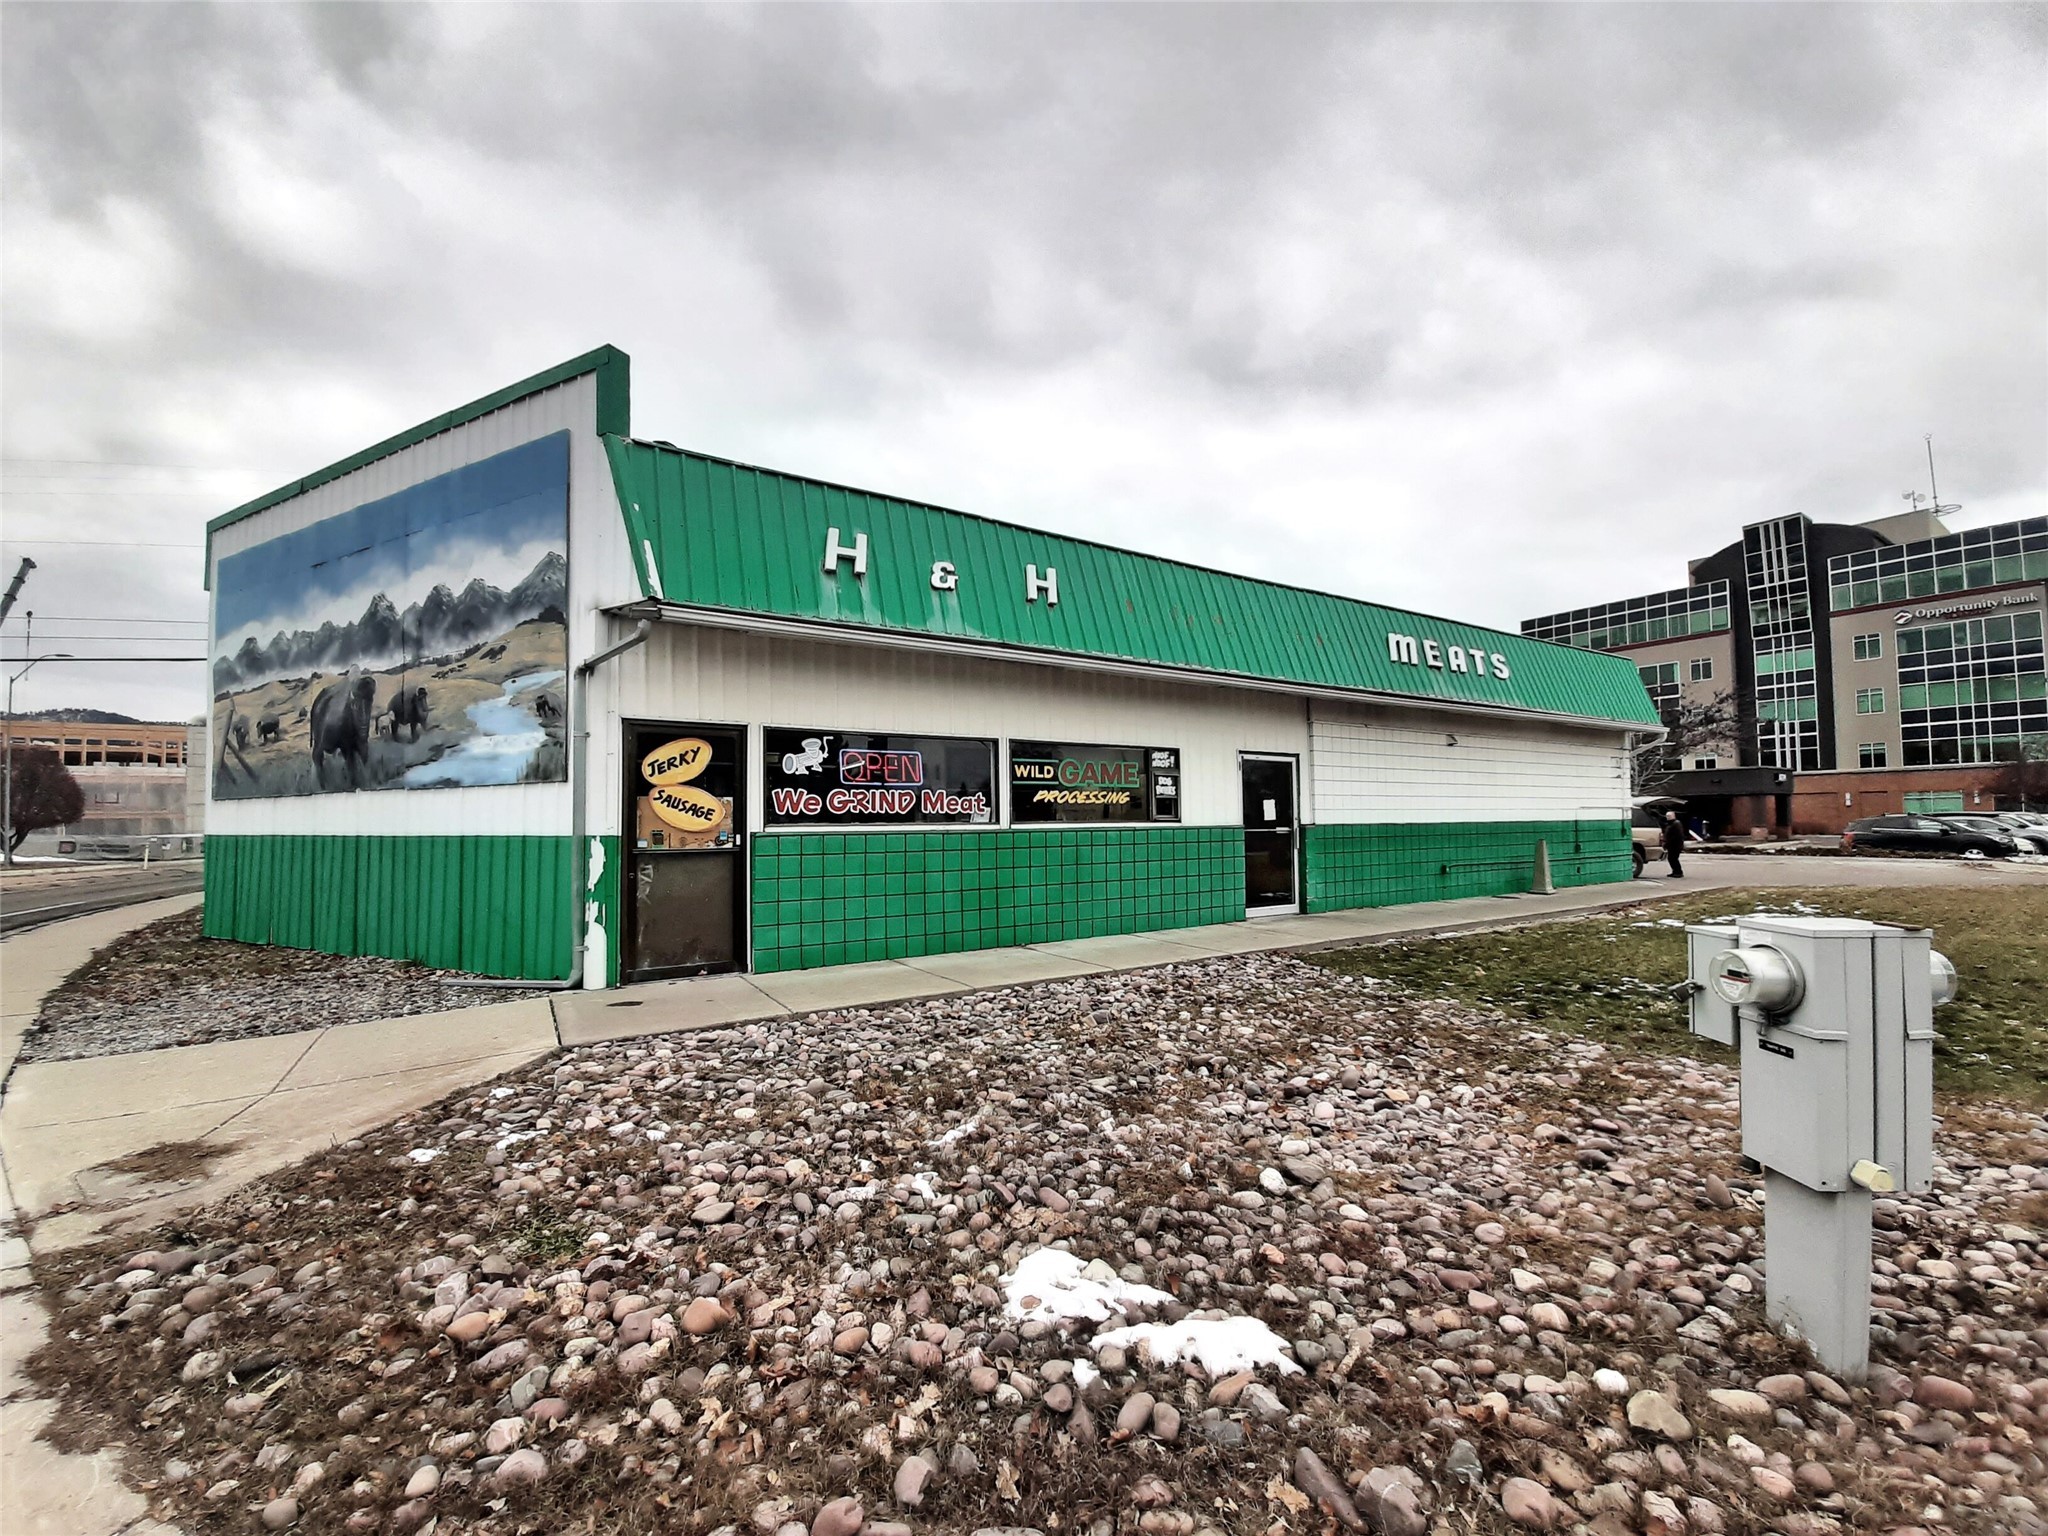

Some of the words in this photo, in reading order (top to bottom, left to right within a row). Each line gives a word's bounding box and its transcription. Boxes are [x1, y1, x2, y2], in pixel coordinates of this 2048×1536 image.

[824, 527, 868, 574] H
[931, 561, 958, 590] &
[1025, 563, 1059, 606] H
[1387, 632, 1511, 680] MEATS
[1915, 599, 2000, 619] Opportunity
[2003, 592, 2039, 606] Bank
[647, 746, 701, 777] JERKY
[842, 751, 921, 783] OPEN
[1014, 764, 1055, 779] WILD
[1058, 758, 1140, 788] GAME
[652, 789, 716, 821] SAUSAGE
[772, 788, 823, 815] We
[826, 788, 916, 815] GRIND
[921, 790, 987, 815] Meat
[1032, 790, 1131, 805] PROCESSING
